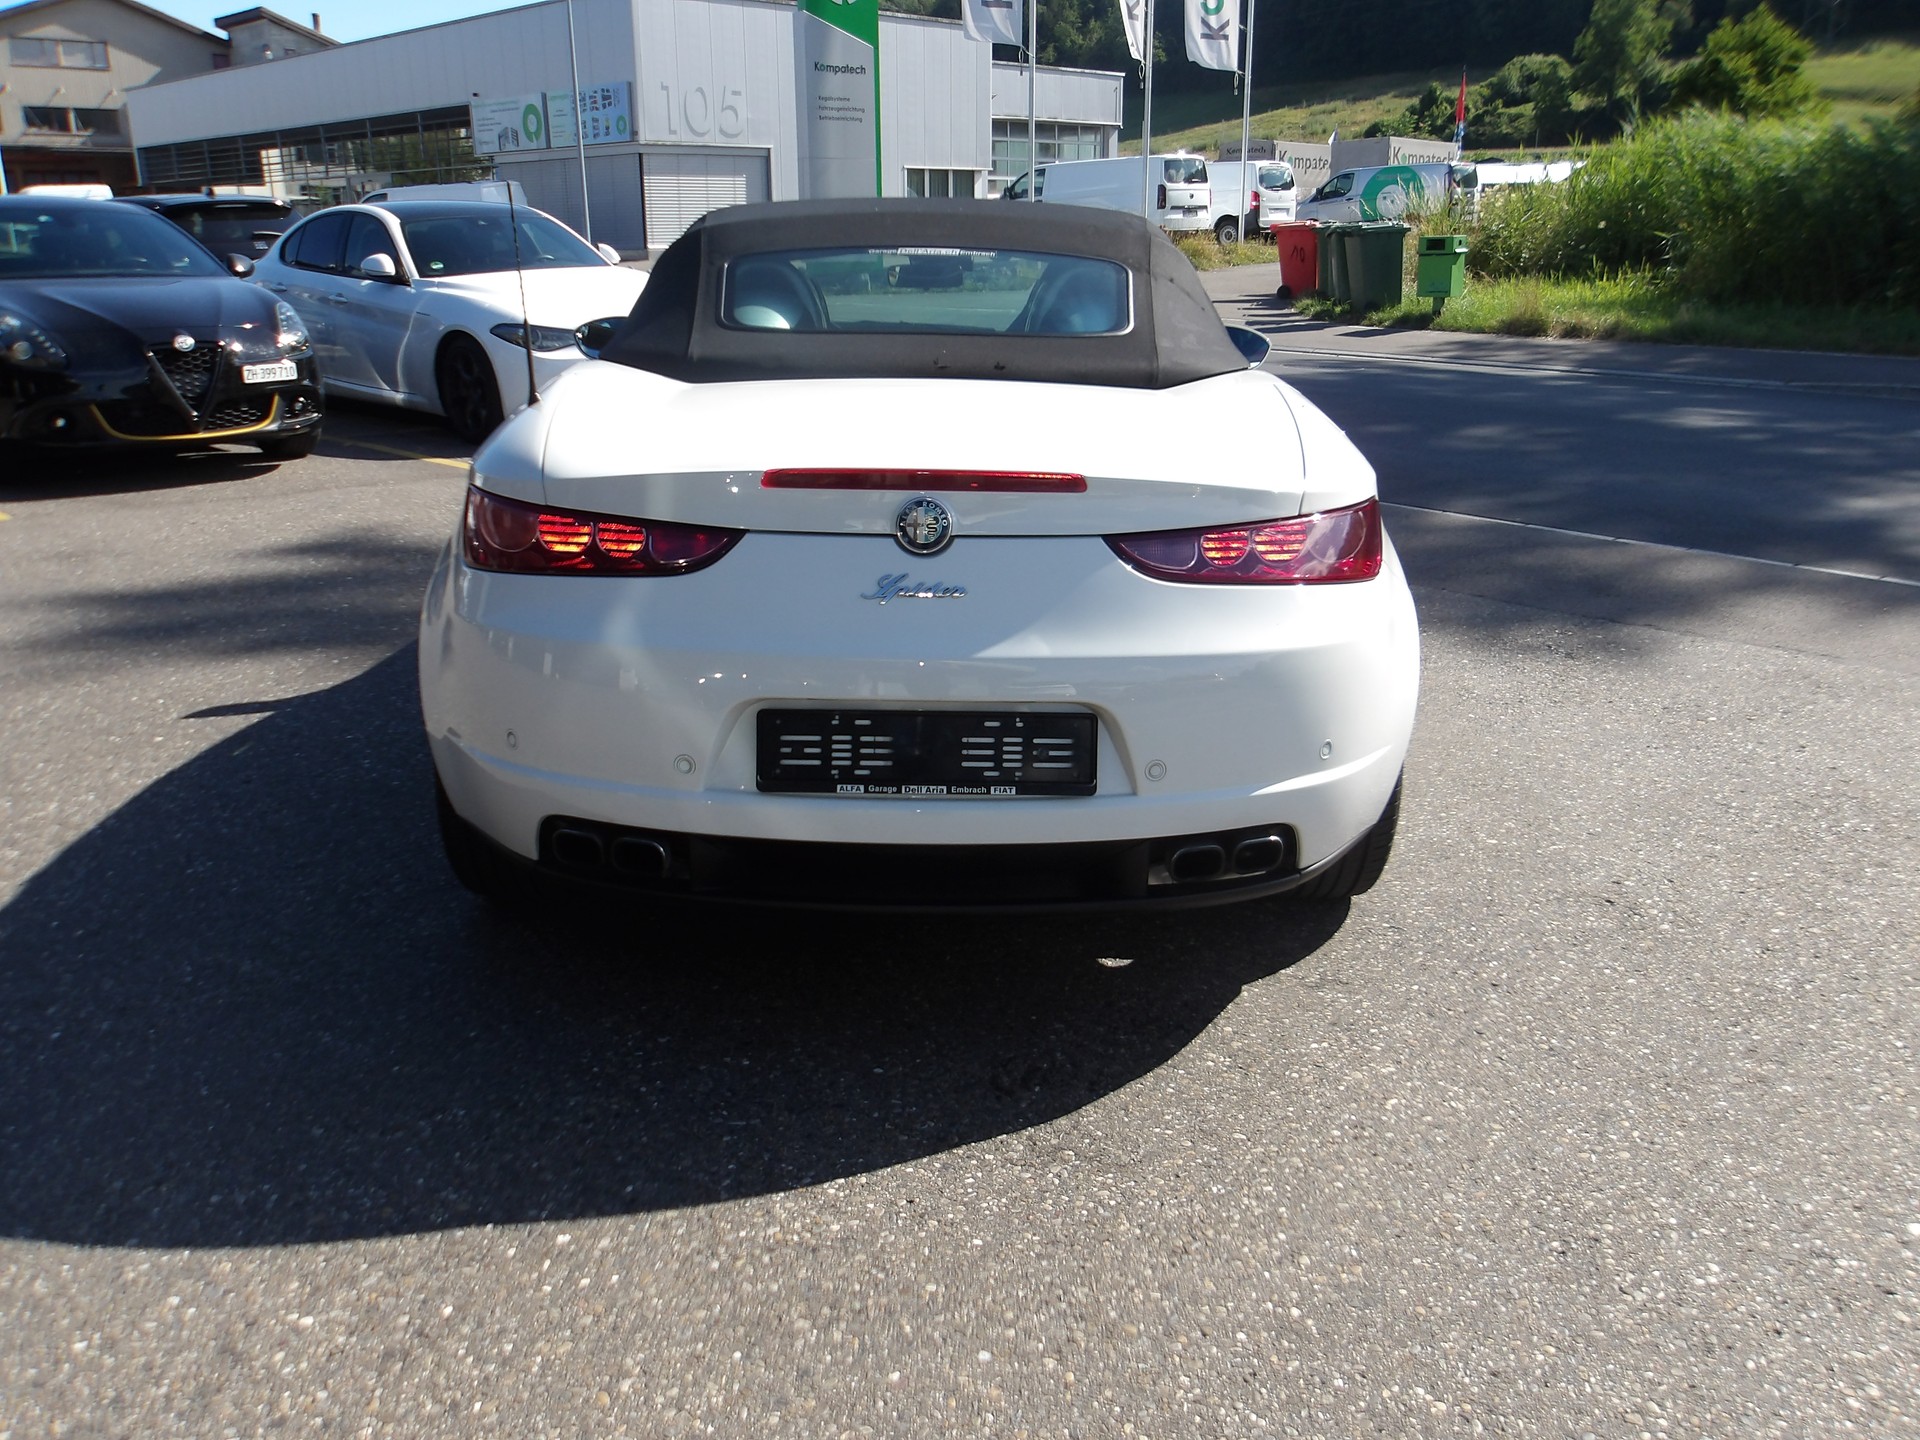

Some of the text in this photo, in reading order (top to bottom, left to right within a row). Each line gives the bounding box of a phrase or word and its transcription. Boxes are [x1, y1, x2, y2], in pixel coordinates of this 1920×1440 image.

[814, 61, 866, 75] Kompatech
[660, 81, 744, 138] 105
[922, 501, 948, 527] ROMEO
[860, 572, 968, 605] Spider
[839, 785, 862, 793] ALFA
[868, 784, 898, 794] Garage
[951, 785, 987, 794] Embrach
[993, 786, 1014, 794] FIAT
